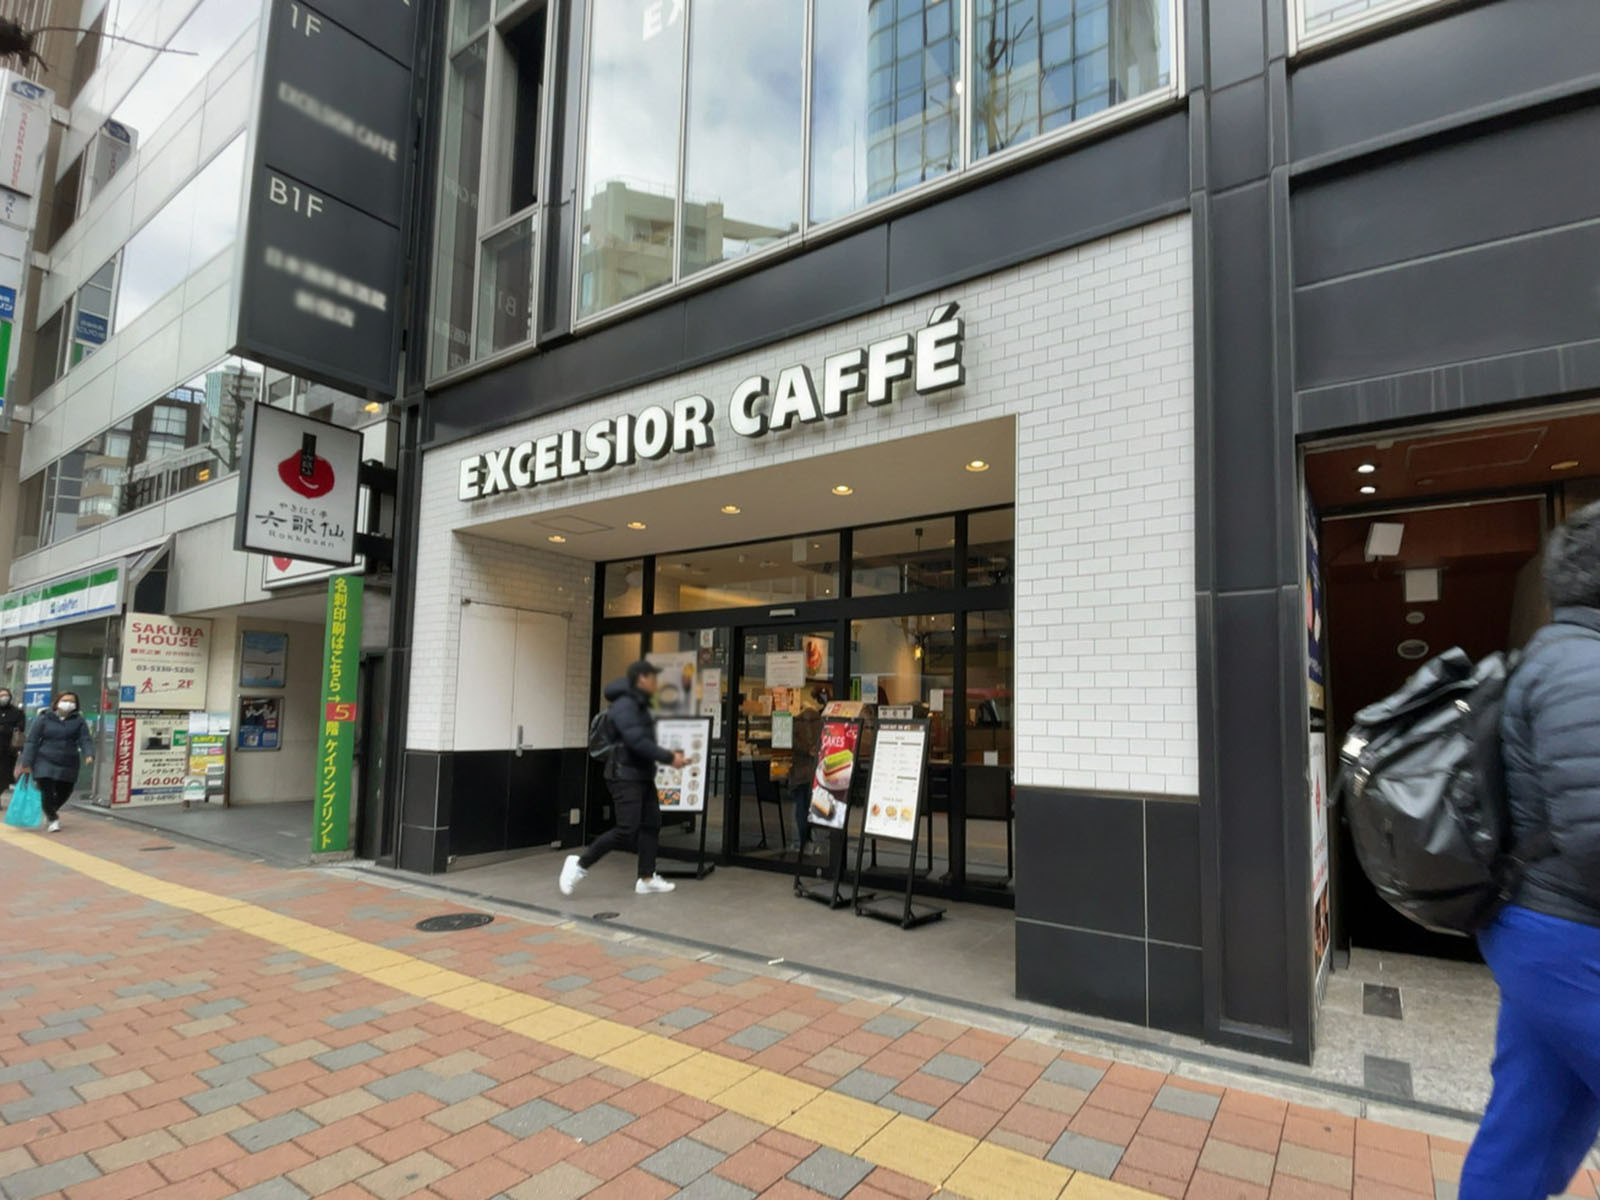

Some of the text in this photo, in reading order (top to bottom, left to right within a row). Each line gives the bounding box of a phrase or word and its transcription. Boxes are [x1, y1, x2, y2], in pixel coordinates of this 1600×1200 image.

[290, 3, 322, 38] 1F
[268, 176, 325, 219] B1F
[457, 301, 966, 501] EXCELSIOR CAFFÉ
[131, 622, 205, 638] SAKURA
[136, 634, 200, 648] HOUSE
[177, 679, 195, 690] 2F
[821, 735, 846, 748] CAKES
